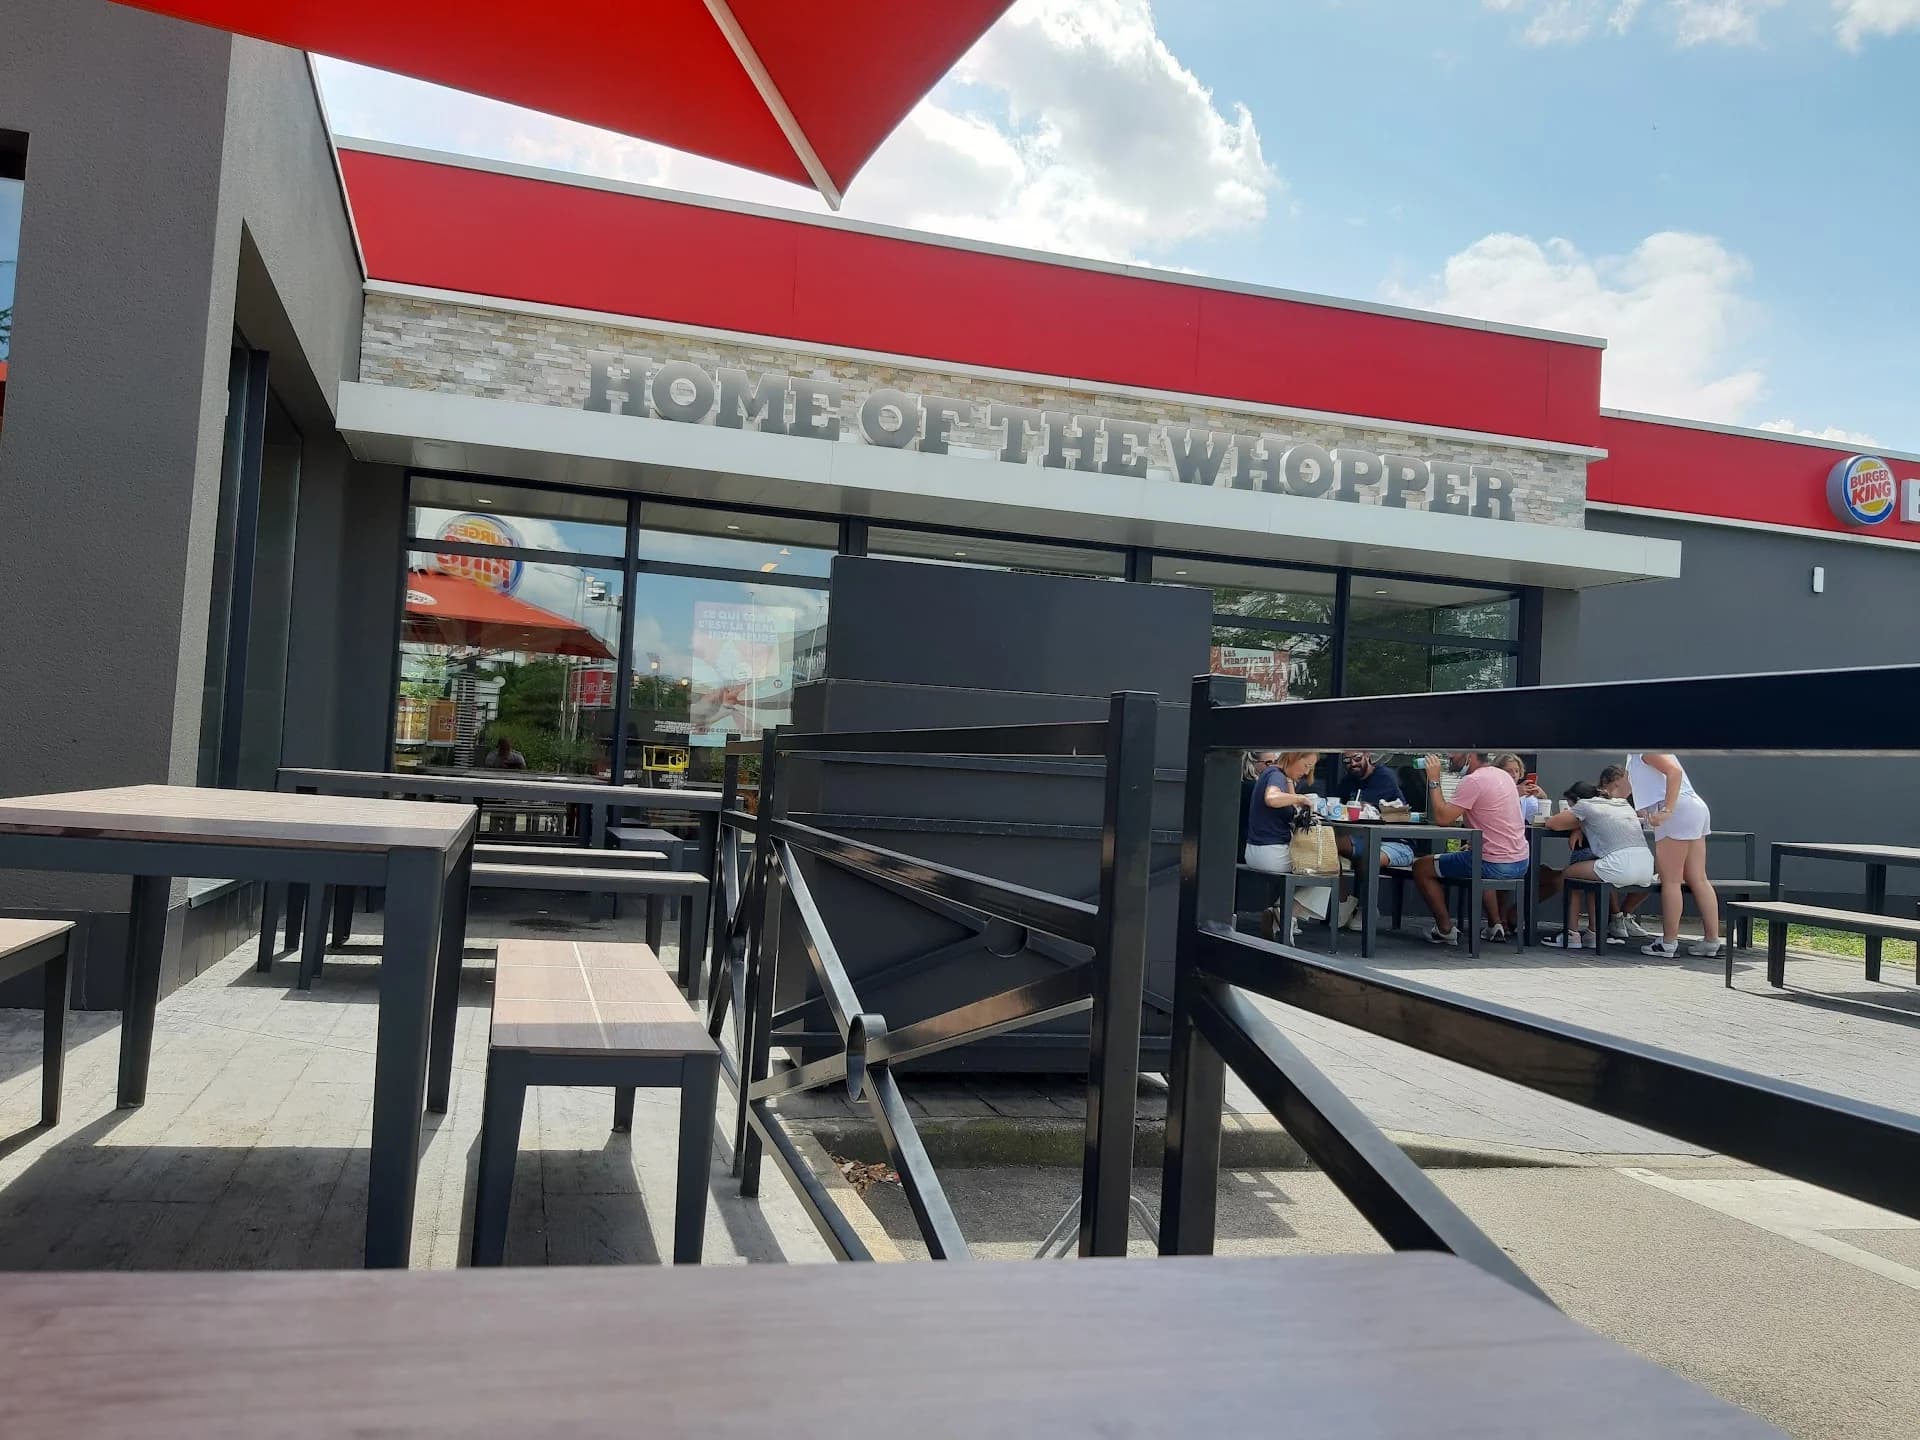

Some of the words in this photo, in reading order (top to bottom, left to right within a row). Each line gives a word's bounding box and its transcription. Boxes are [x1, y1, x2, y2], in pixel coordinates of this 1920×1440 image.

[583, 350, 841, 442] HOME
[859, 389, 973, 455] OF
[987, 403, 1150, 479] THE
[1164, 426, 1515, 522] WHOPPER
[1851, 469, 1889, 489] BURGER
[1852, 481, 1891, 505] KING
